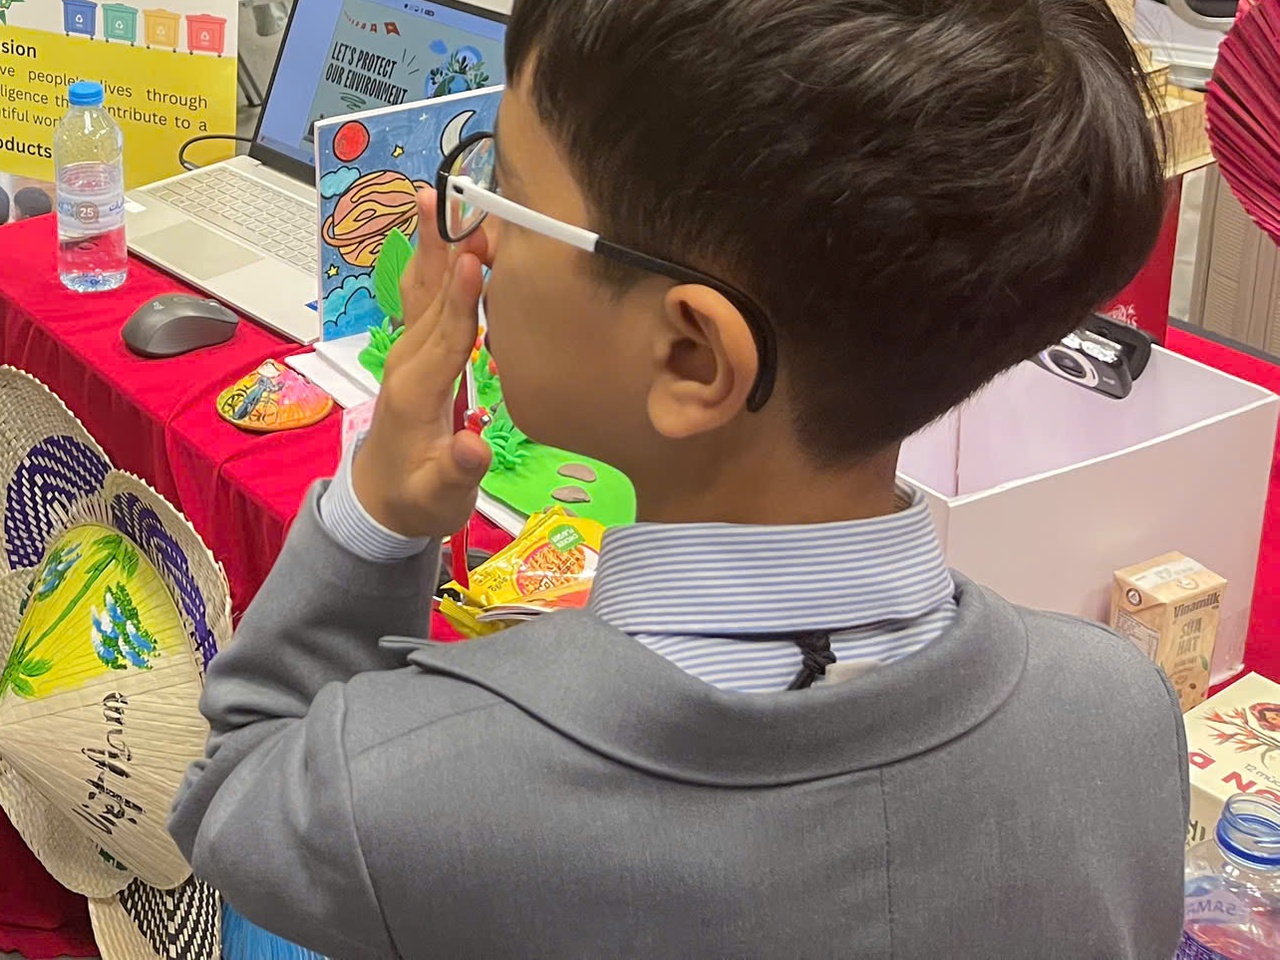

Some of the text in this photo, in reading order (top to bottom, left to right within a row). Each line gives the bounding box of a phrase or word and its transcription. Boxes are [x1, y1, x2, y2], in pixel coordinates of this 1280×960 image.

[331, 41, 397, 80] LET'S PROTECT
[28, 68, 85, 88] people'
[146, 88, 208, 110] through
[325, 62, 408, 105] OUR ENVIRONMENT
[32, 114, 61, 129] wor
[103, 105, 167, 126] ntribute
[174, 114, 191, 130] to
[198, 120, 208, 133] a
[79, 207, 94, 218] 25
[1174, 591, 1220, 619] Vinamilk
